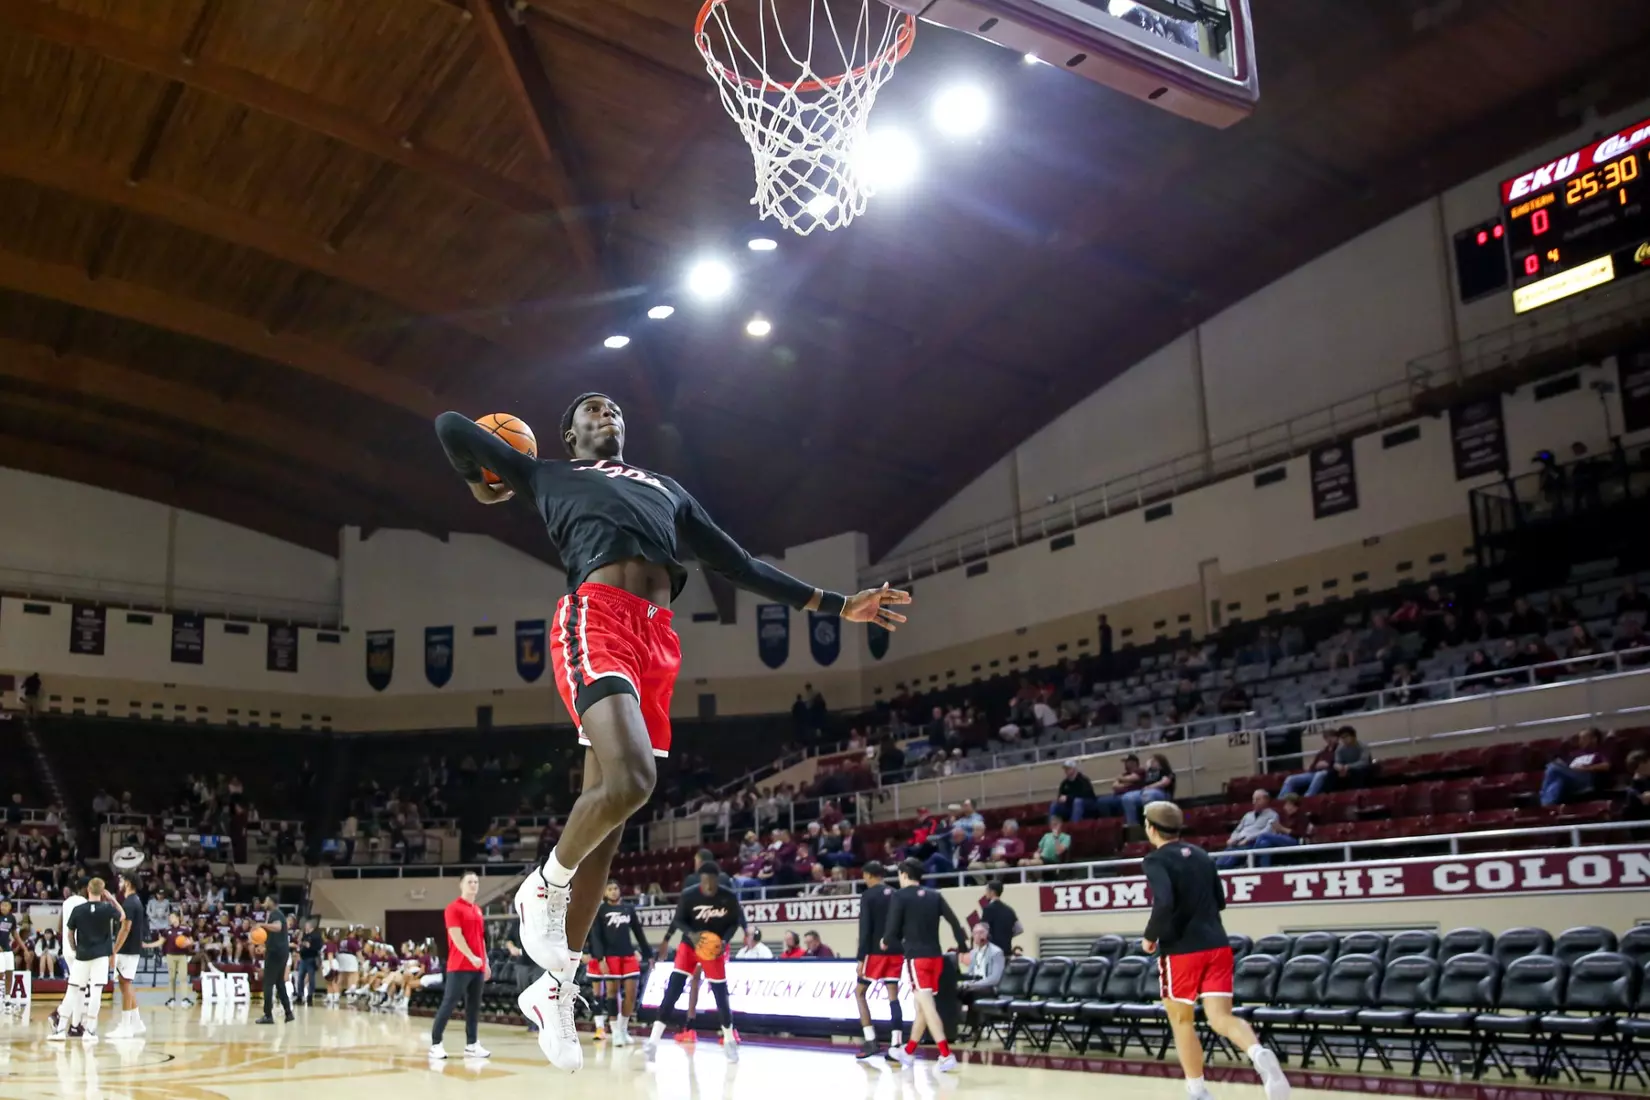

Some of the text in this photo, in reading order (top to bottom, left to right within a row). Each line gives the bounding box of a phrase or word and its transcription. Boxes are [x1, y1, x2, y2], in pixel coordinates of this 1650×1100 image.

[1508, 152, 1580, 201] EKU
[1566, 155, 1638, 204] 25:30
[1619, 188, 1627, 205] 1
[1531, 208, 1549, 236] 0
[1524, 253, 1540, 276] 0
[1054, 853, 1650, 910] HOM F THE COLON
[604, 912, 631, 928] Tops
[692, 905, 728, 923] Tops
[10, 974, 27, 998] A
[728, 979, 807, 998] ENTUCKY
